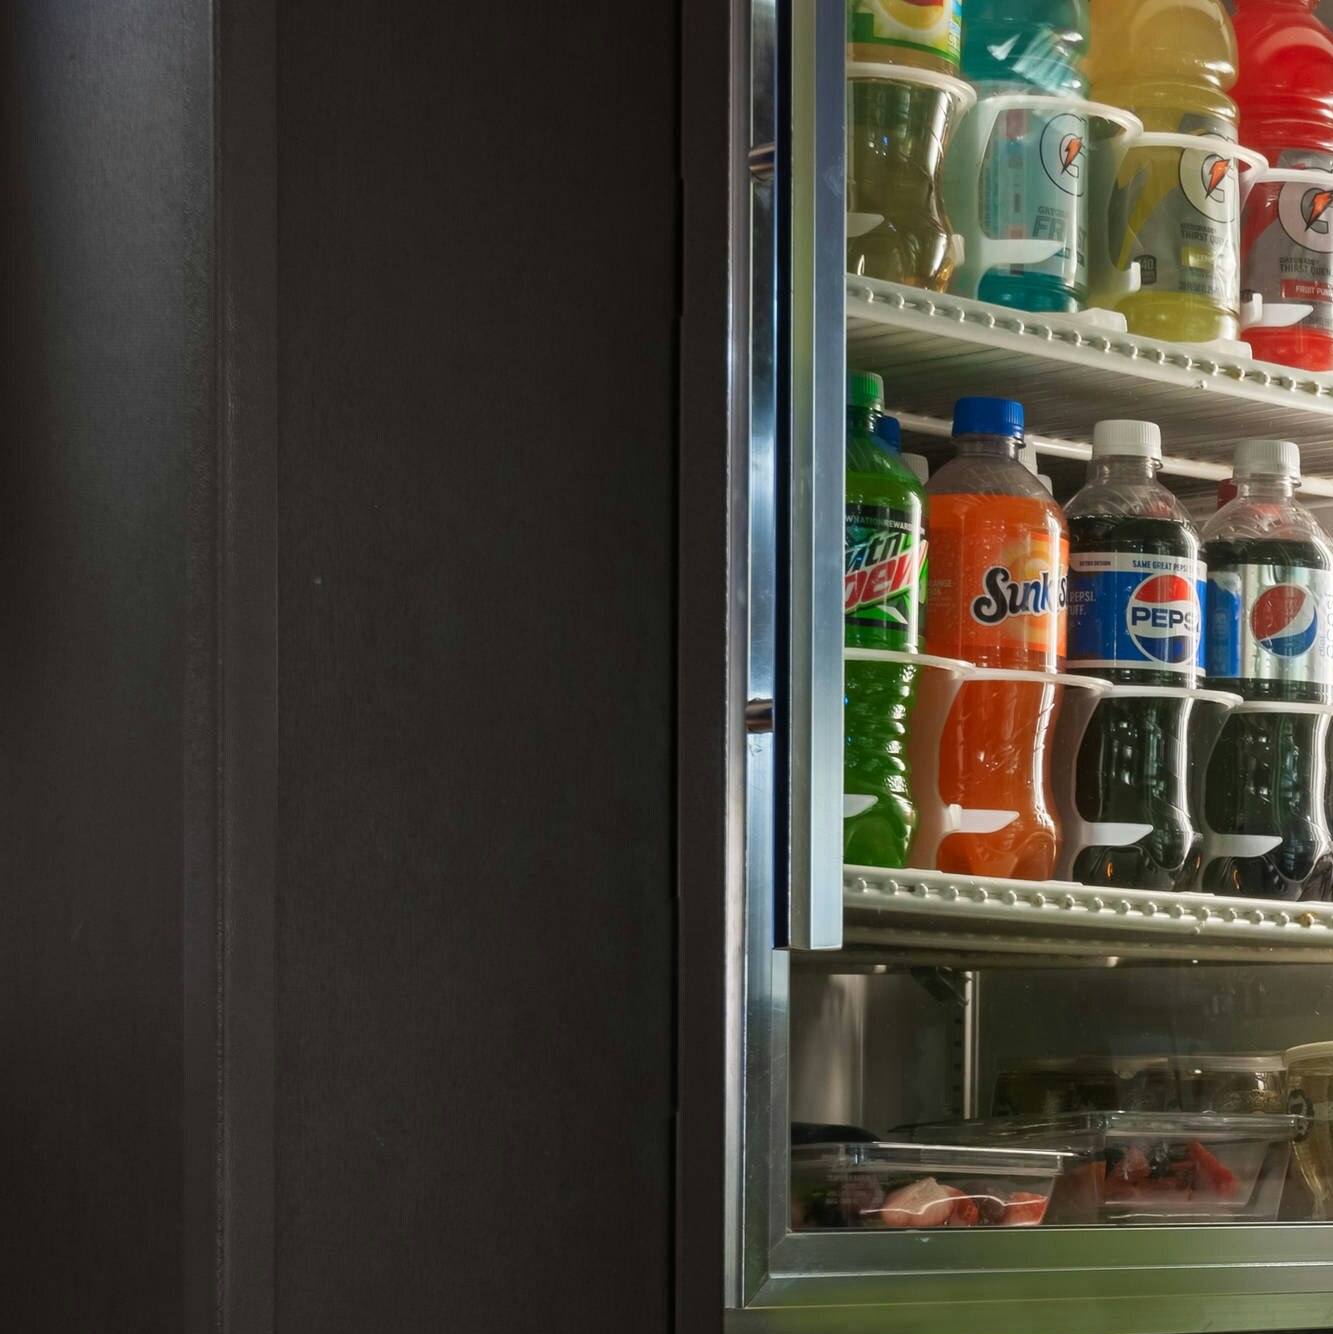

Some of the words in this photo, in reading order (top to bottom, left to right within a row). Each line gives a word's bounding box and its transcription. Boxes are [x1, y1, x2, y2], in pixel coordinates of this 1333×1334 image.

[1132, 559, 1152, 569] SAME
[1152, 560, 1172, 571] GREAT
[1131, 606, 1200, 633] PEPSI
